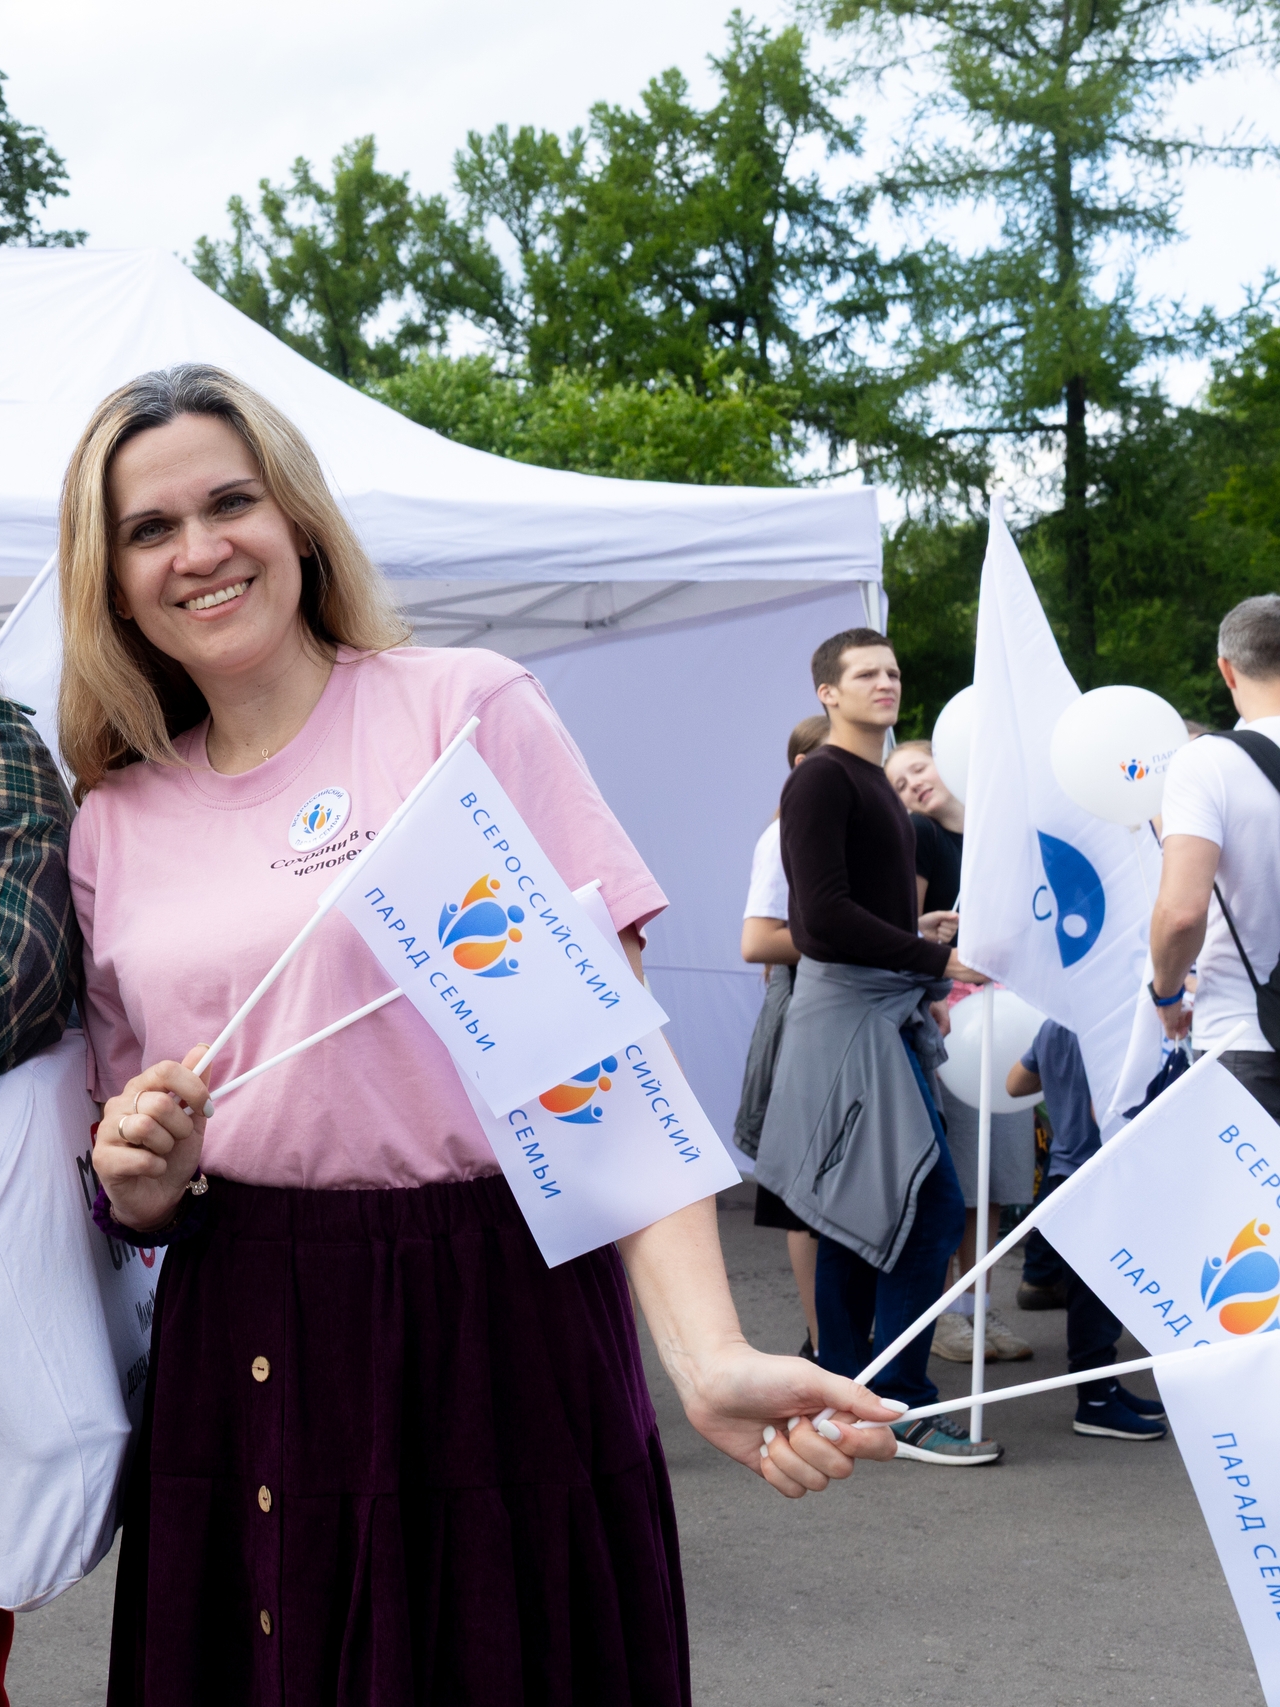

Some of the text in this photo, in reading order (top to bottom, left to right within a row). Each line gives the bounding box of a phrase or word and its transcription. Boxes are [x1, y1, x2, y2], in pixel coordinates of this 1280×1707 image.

[270, 839, 348, 869] Сохрани
[349, 829, 360, 841] в
[460, 792, 620, 1009] ВСЕРОССИЙСКИЙ
[364, 887, 496, 1052] ПАРАД СЕМЬИ
[508, 1109, 562, 1199] СЕМЬИ
[625, 1044, 701, 1163] СИЙСКИЙ
[1218, 1124, 1280, 1208] ВСЕР
[1109, 1248, 1192, 1337] ПАРАД
[1212, 1432, 1280, 1621] ПАРАД СЕМ
